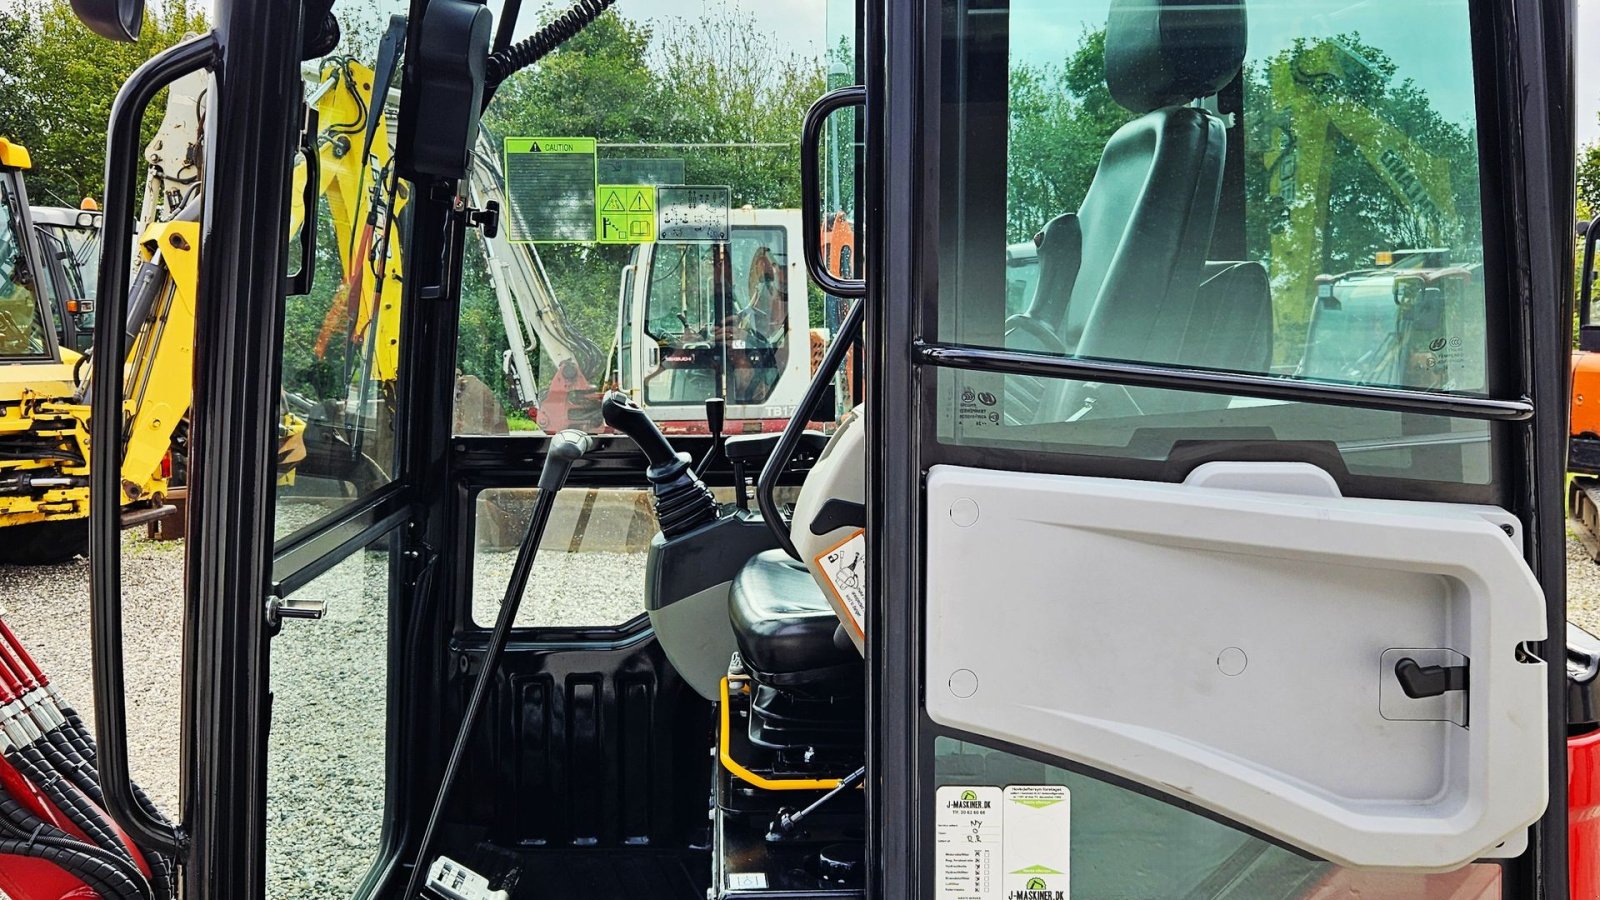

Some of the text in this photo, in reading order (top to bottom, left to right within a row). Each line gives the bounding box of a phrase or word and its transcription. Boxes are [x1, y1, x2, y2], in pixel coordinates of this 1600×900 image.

[544, 143, 574, 152] CAUTION
[946, 801, 991, 809] J-MASKINER.DK
[1008, 890, 1064, 900] J-MASKINER.DK
